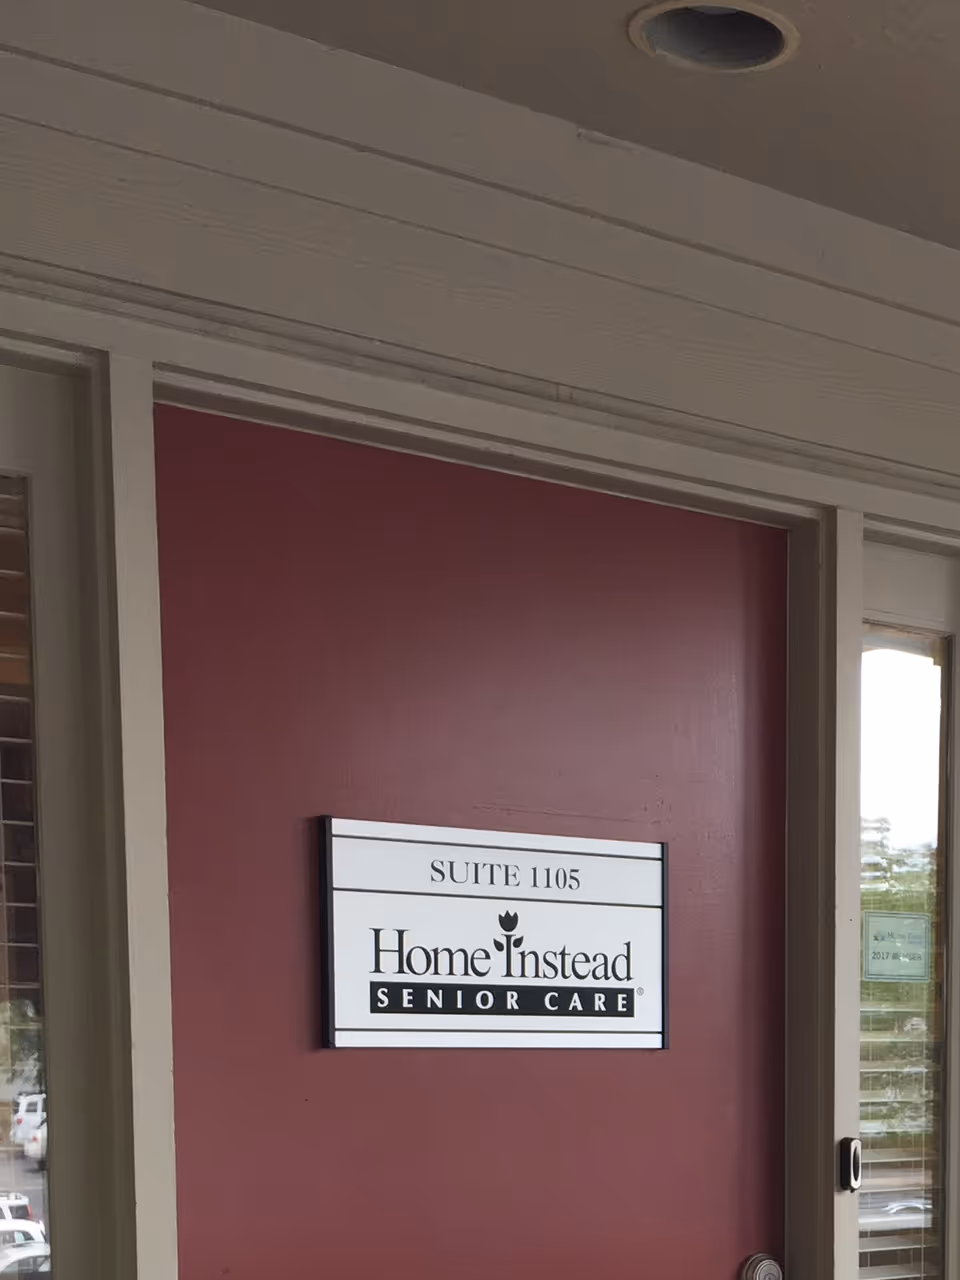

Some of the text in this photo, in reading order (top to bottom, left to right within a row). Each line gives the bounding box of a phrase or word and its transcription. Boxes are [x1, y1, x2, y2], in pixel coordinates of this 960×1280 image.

[430, 859, 581, 890] SUITE 1105
[369, 927, 635, 983] Home Instead
[376, 987, 628, 1012] SENIOR CARE
